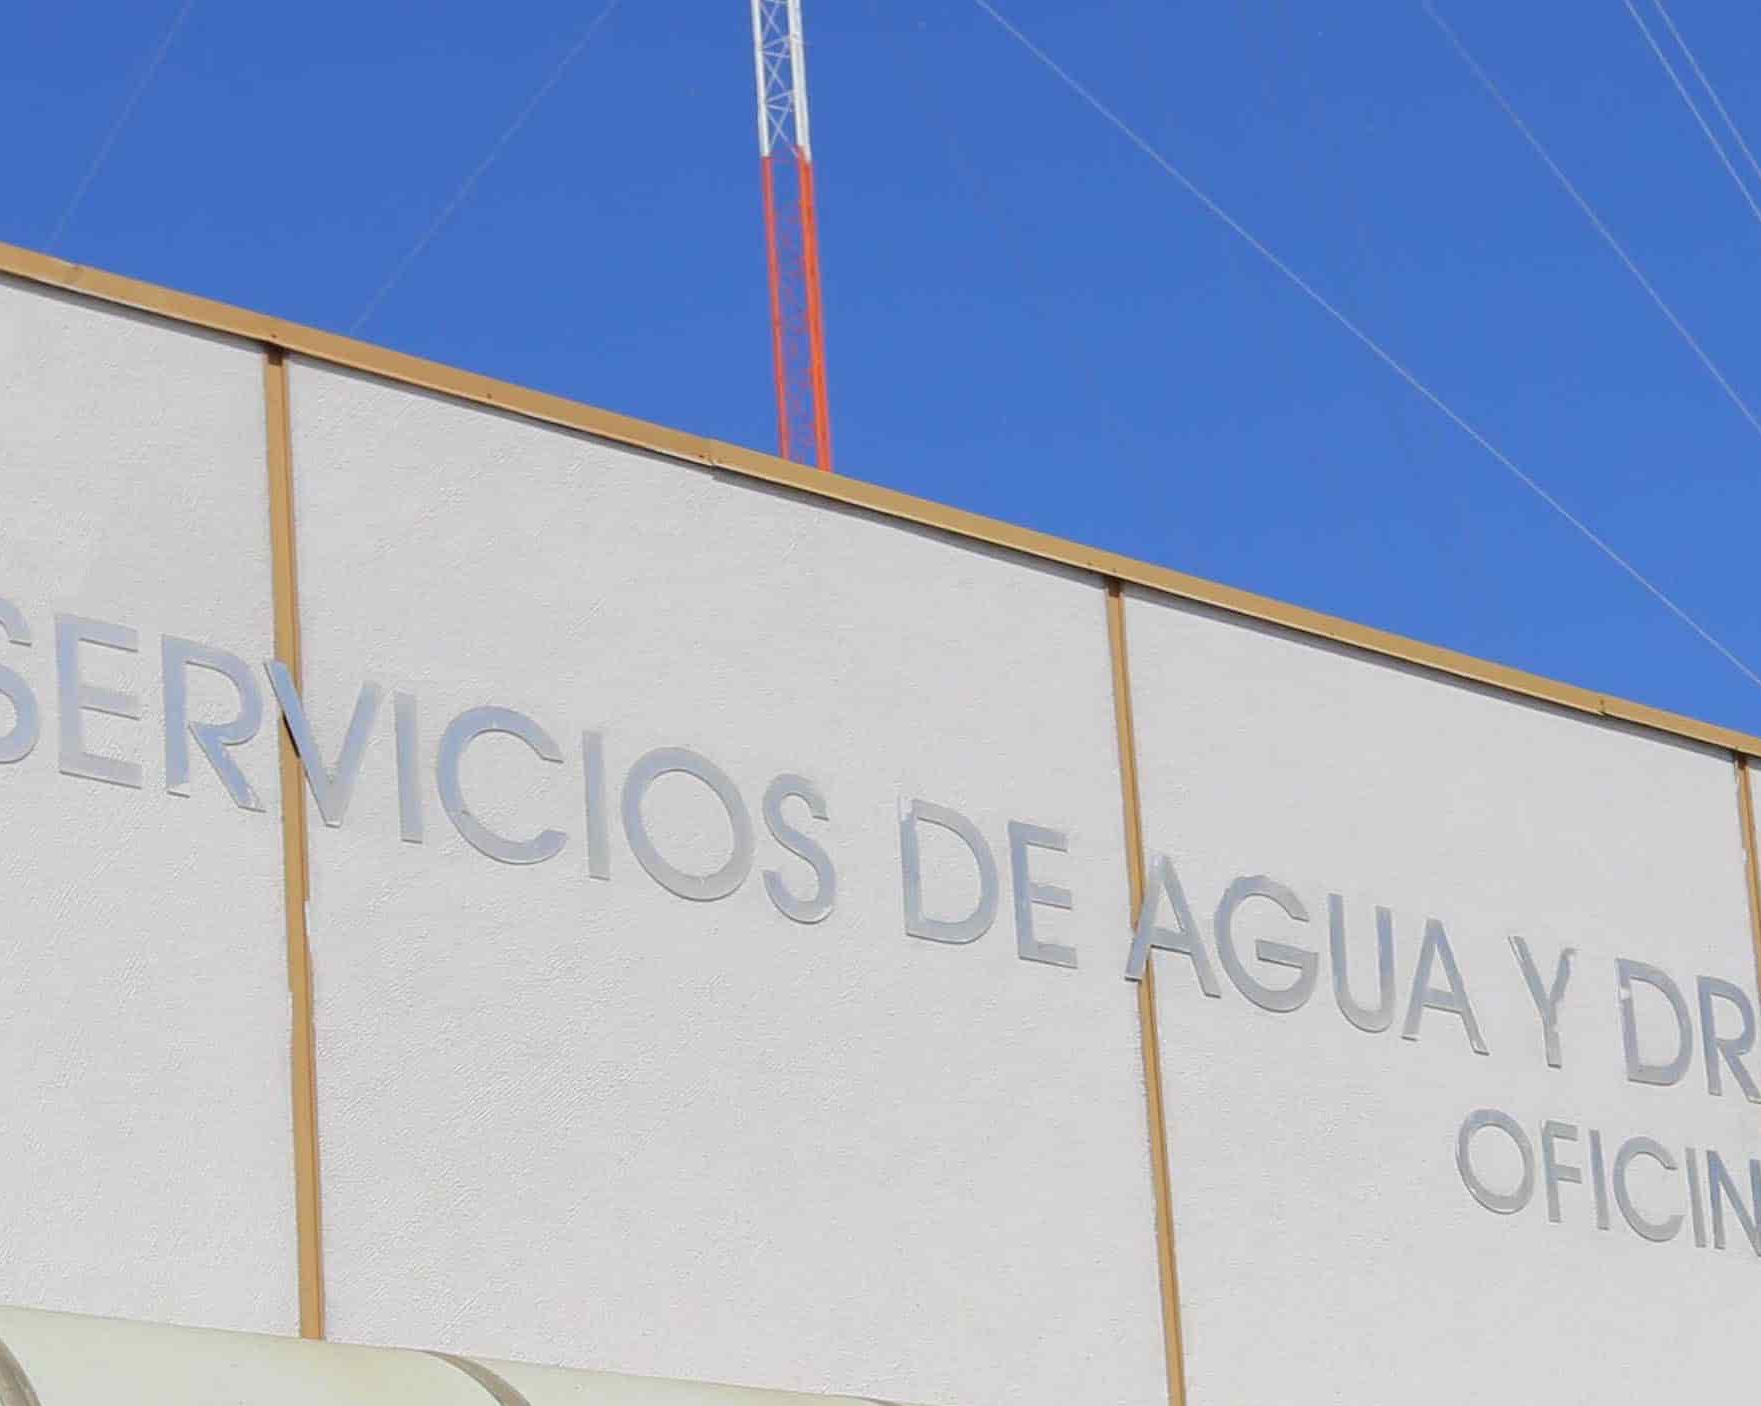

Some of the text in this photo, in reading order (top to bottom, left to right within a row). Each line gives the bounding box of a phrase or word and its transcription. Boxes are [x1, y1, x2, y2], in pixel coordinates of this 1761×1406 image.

[899, 799, 1078, 970] DE
[1123, 855, 1489, 1056] AGUA
[1507, 934, 1577, 1069] Y
